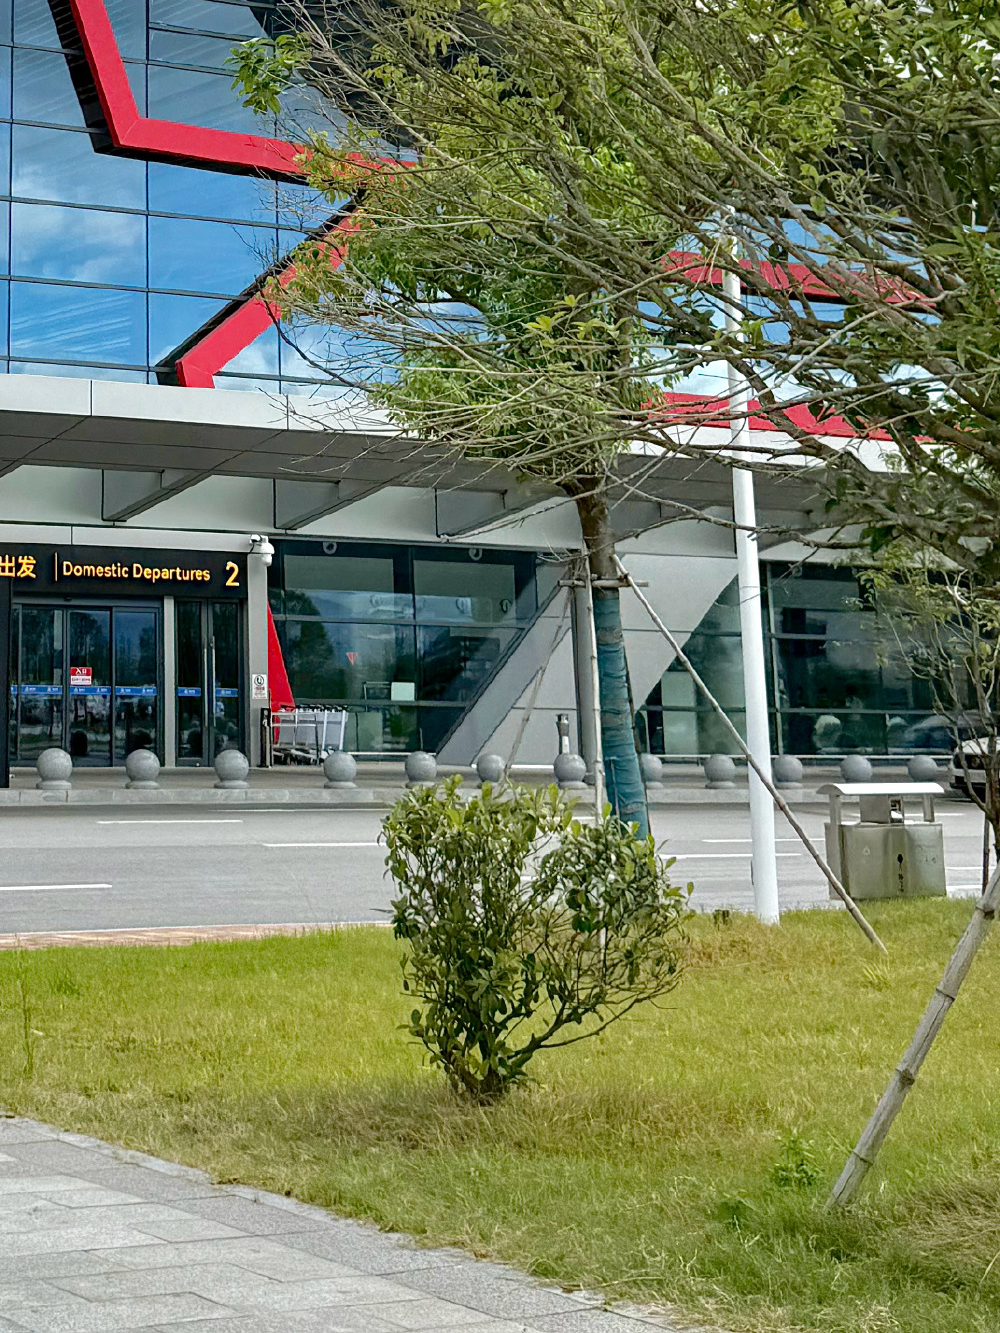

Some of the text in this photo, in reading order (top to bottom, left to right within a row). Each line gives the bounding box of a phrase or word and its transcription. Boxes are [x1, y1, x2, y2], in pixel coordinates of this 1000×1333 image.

[62, 561, 211, 584] Domestic Departures
[225, 560, 240, 587] 2
